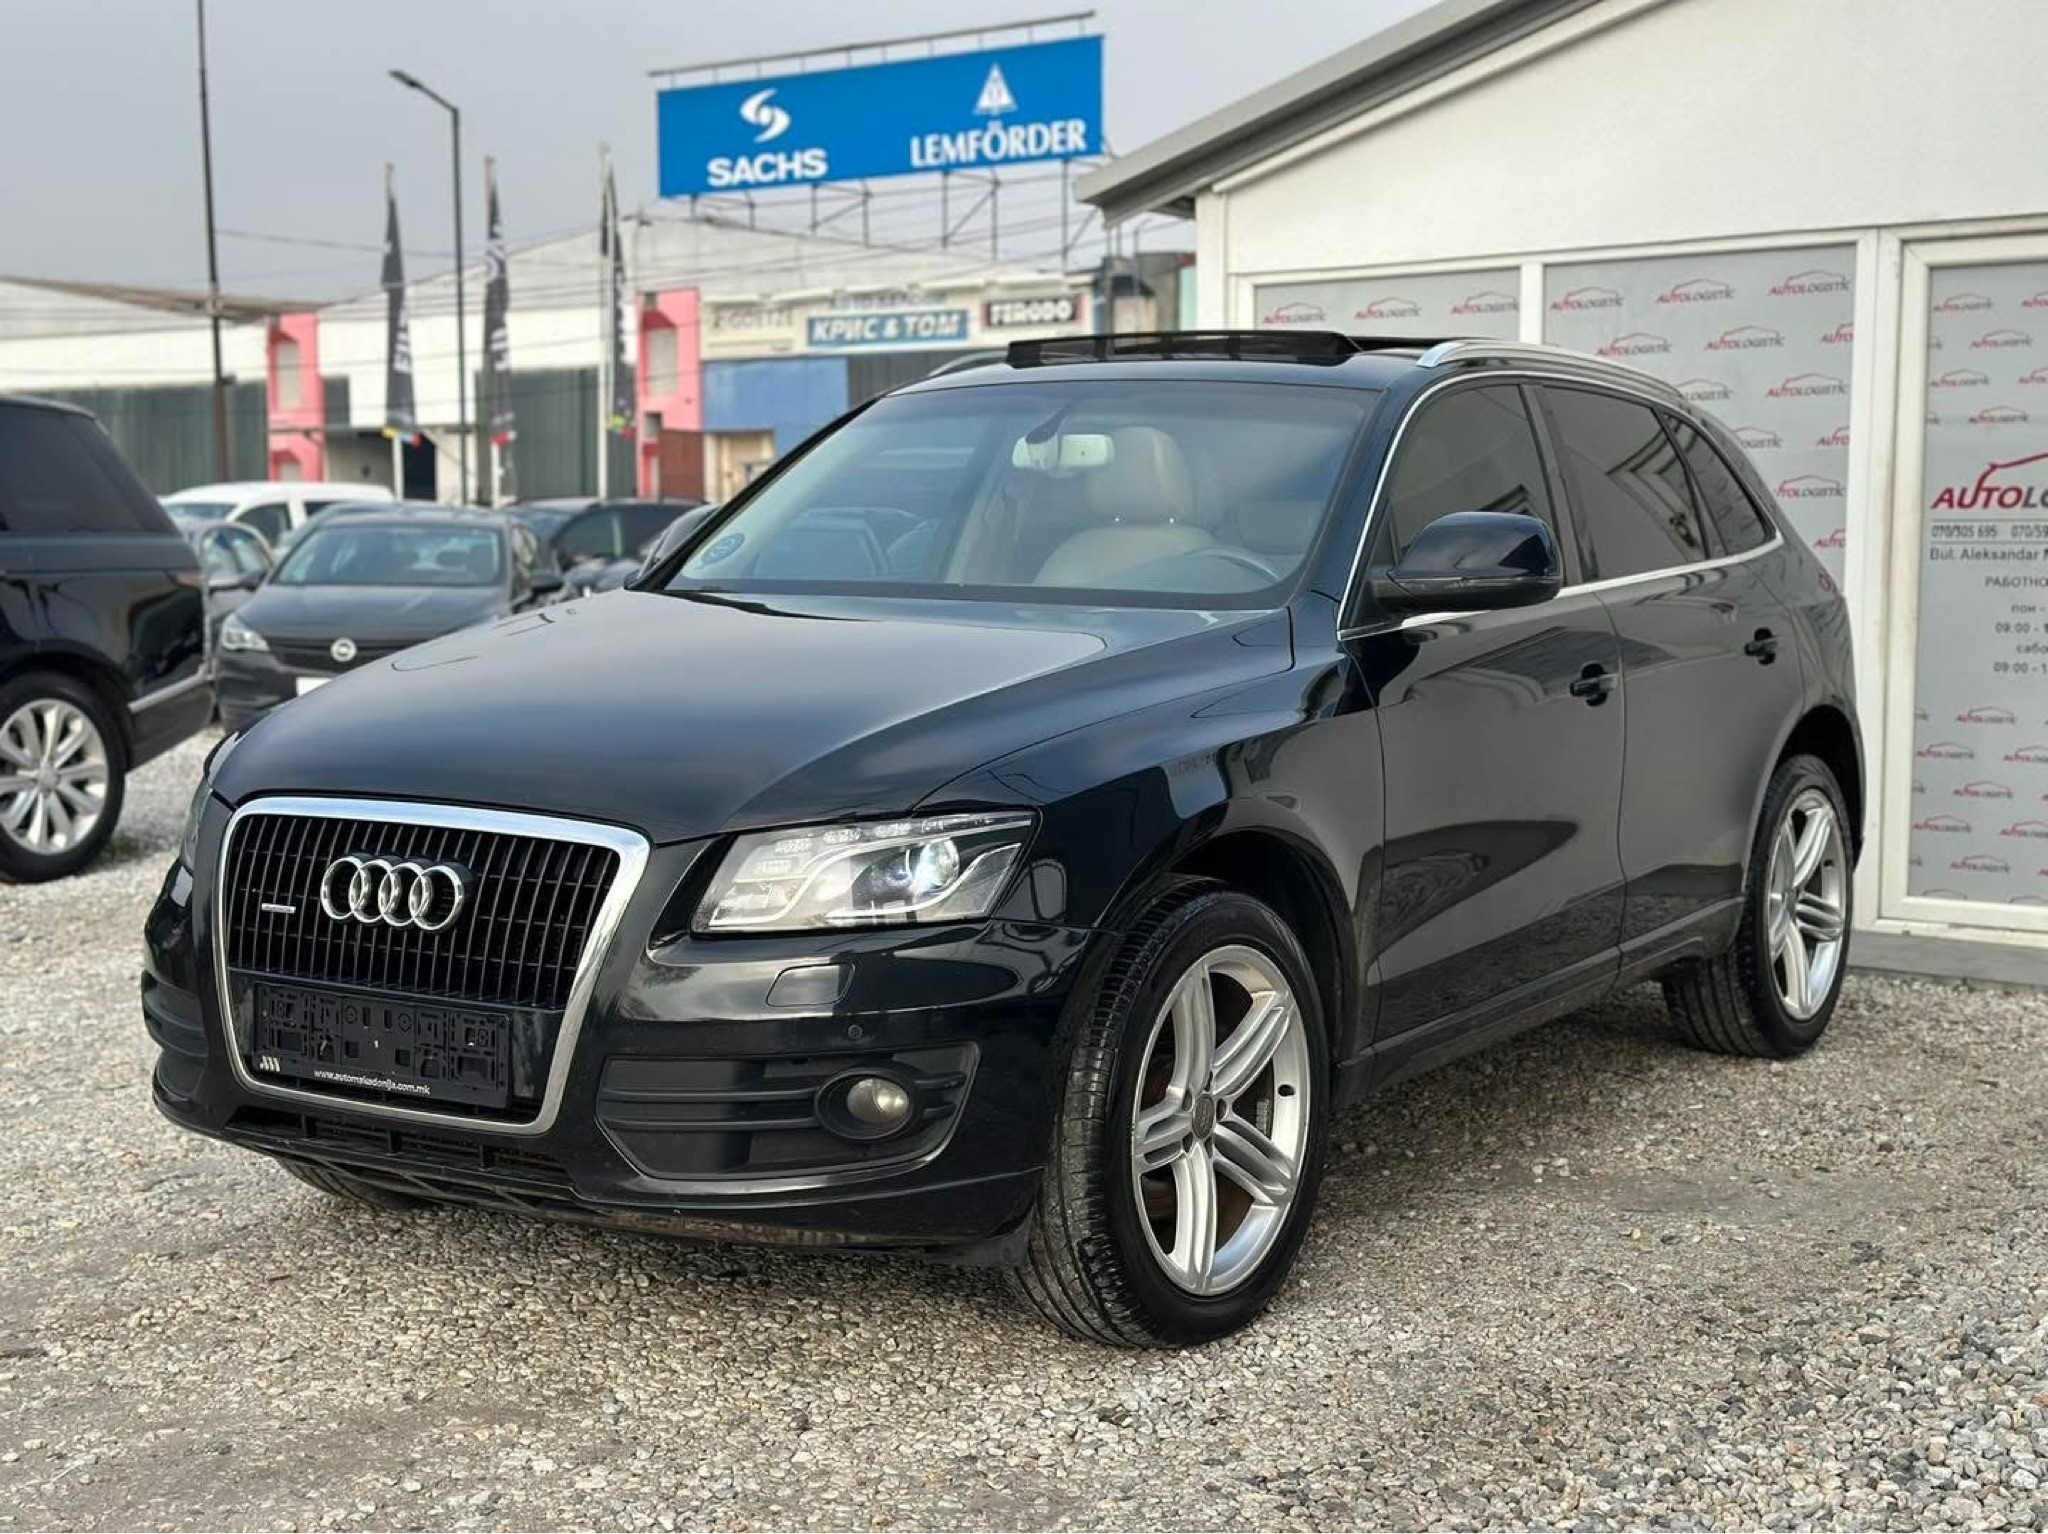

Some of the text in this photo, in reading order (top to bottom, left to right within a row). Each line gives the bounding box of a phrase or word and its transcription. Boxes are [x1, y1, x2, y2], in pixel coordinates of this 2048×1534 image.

[910, 119, 1087, 168] LEMFÖRDER
[707, 147, 829, 188] SACHS
[883, 317, 900, 338] &
[1961, 547, 2038, 560] Aleksandar
